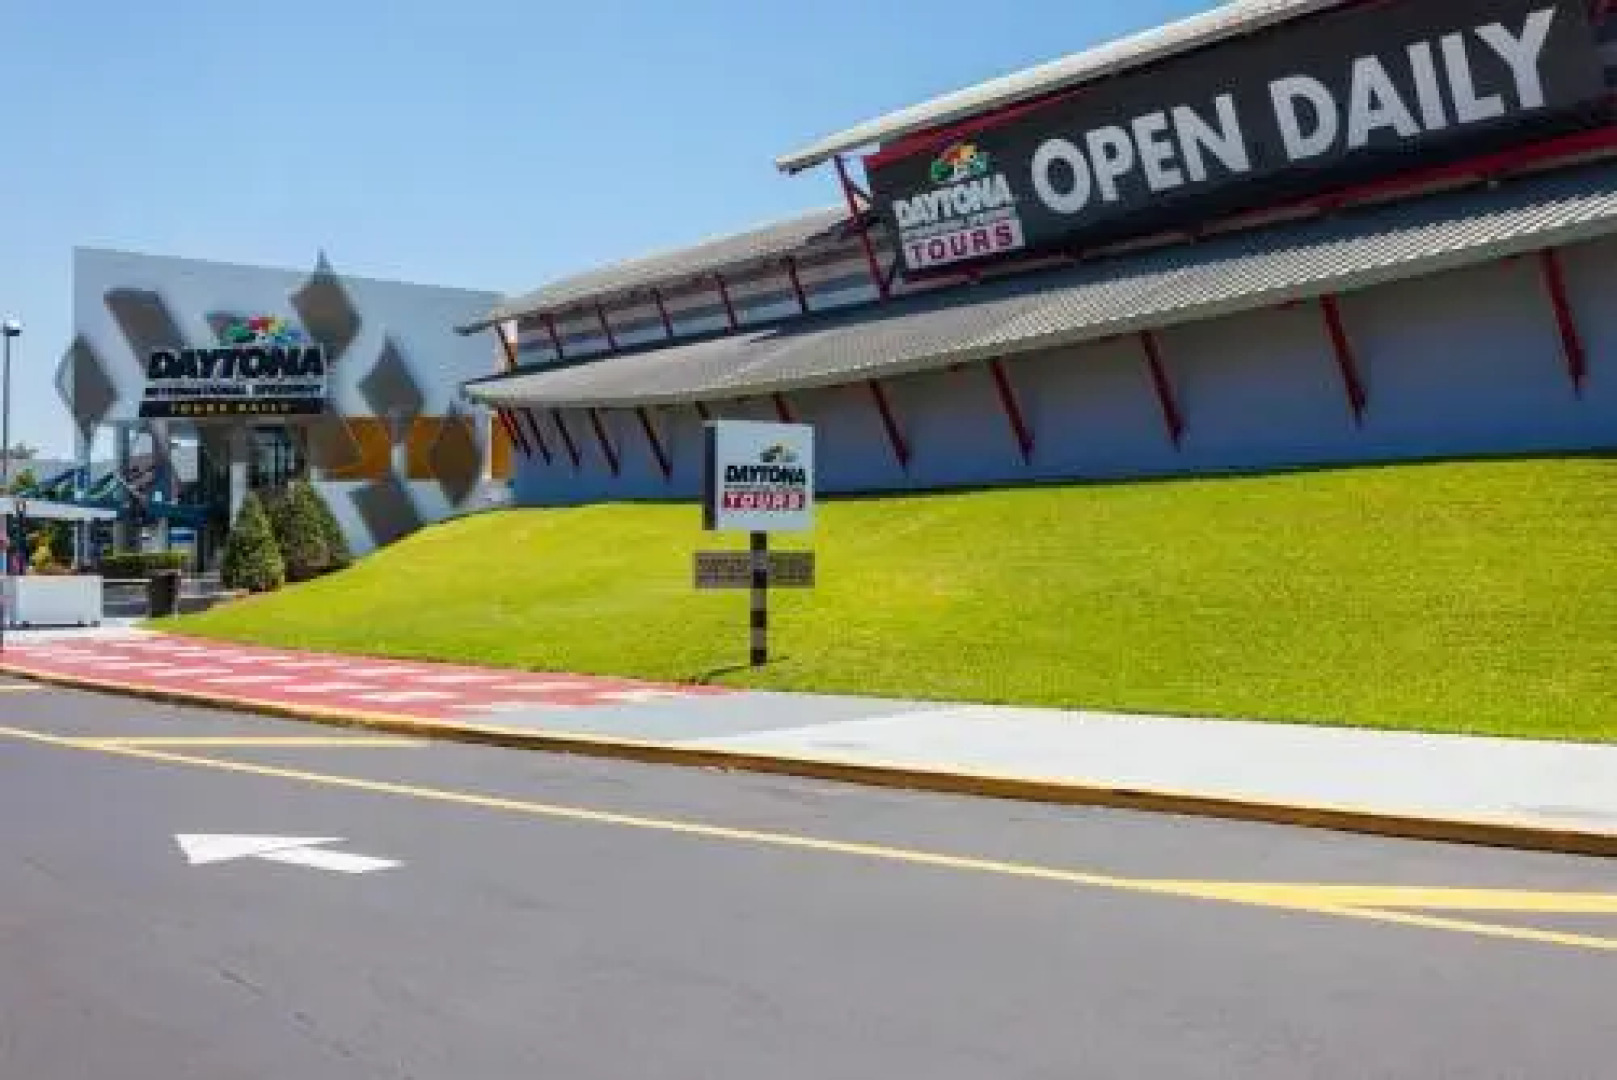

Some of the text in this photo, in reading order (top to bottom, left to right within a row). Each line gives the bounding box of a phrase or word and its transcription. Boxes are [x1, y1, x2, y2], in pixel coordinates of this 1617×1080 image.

[1031, 9, 1556, 214] OPEN DAILY
[893, 174, 1014, 226] DAYTONA
[911, 225, 1013, 260] TOURS
[149, 346, 325, 380] DAYTONA
[724, 465, 806, 485] DAYTONA
[727, 492, 804, 510] TOURS
